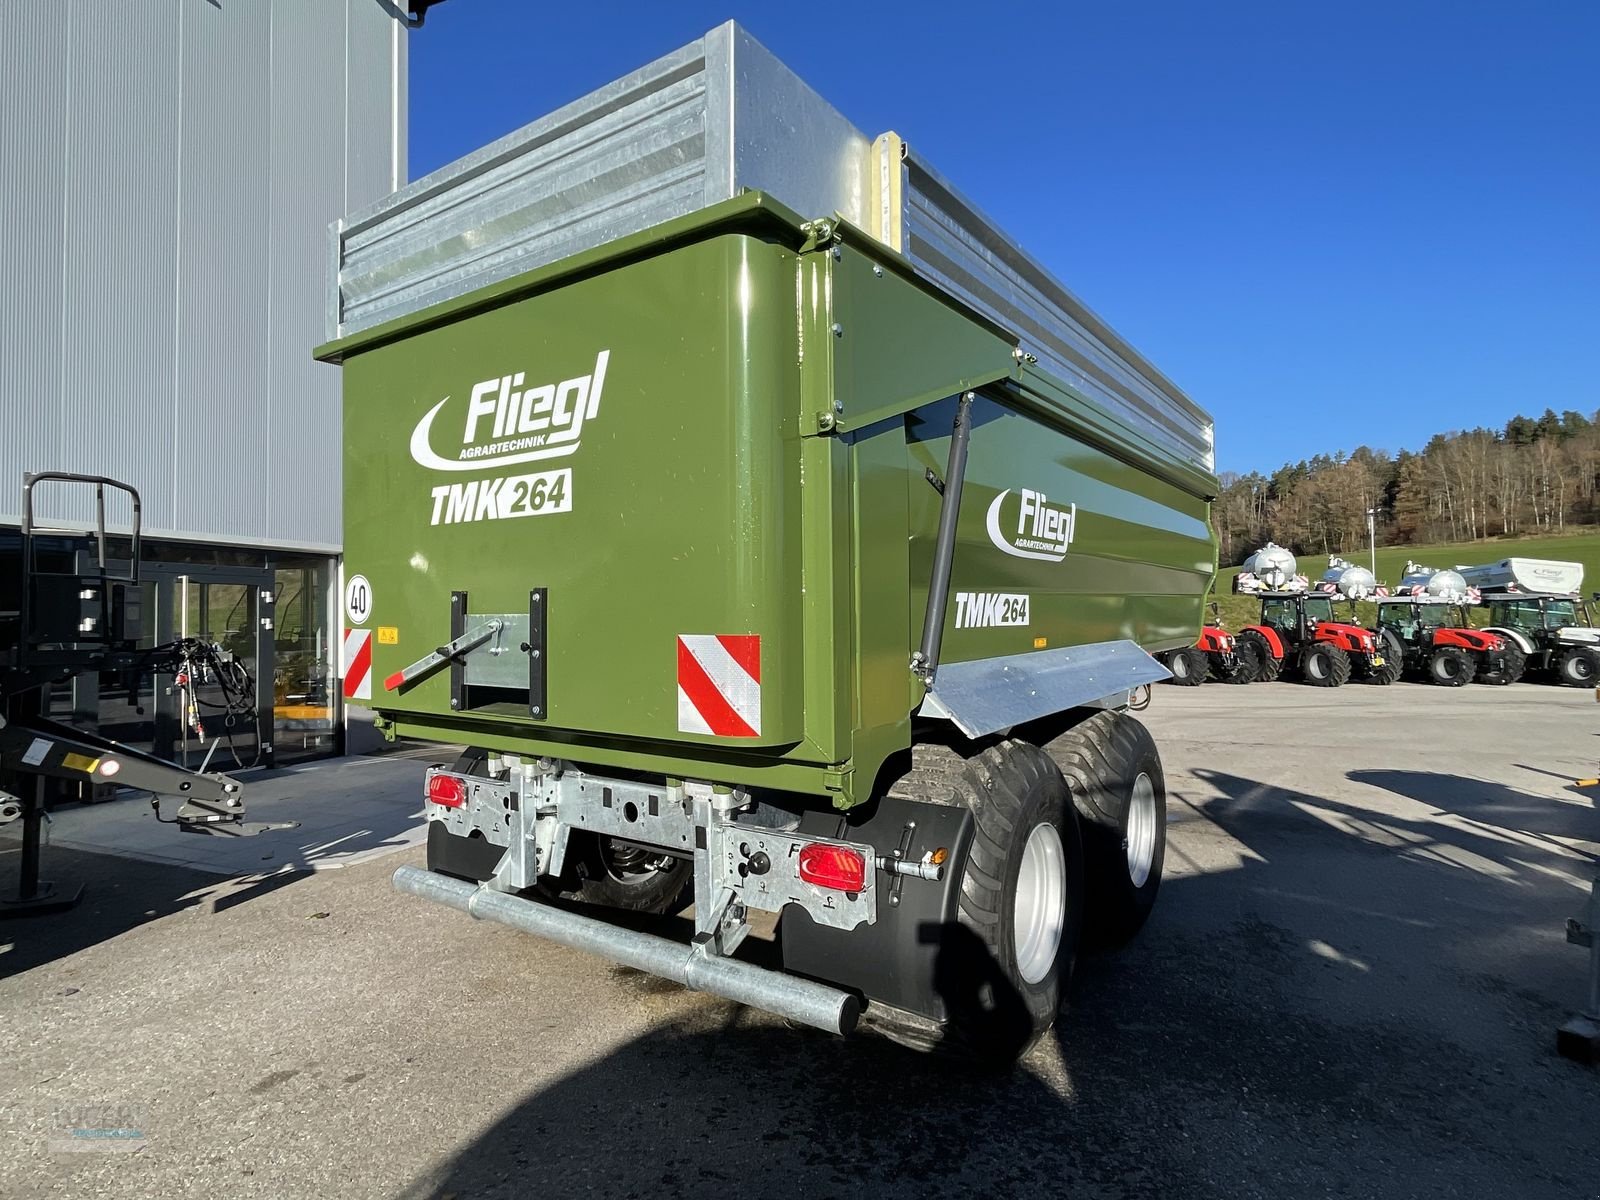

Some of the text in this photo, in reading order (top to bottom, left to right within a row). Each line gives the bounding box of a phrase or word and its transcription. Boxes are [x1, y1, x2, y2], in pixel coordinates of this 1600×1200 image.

[463, 349, 610, 444] Fliegl
[458, 434, 546, 460] AGRARTECHNIK
[430, 475, 567, 526] TMK 264
[1017, 488, 1076, 554] Fliegl
[1014, 537, 1057, 552] AGRARTECHNIK
[351, 584, 366, 614] 40
[954, 592, 1027, 629] TMK 264
